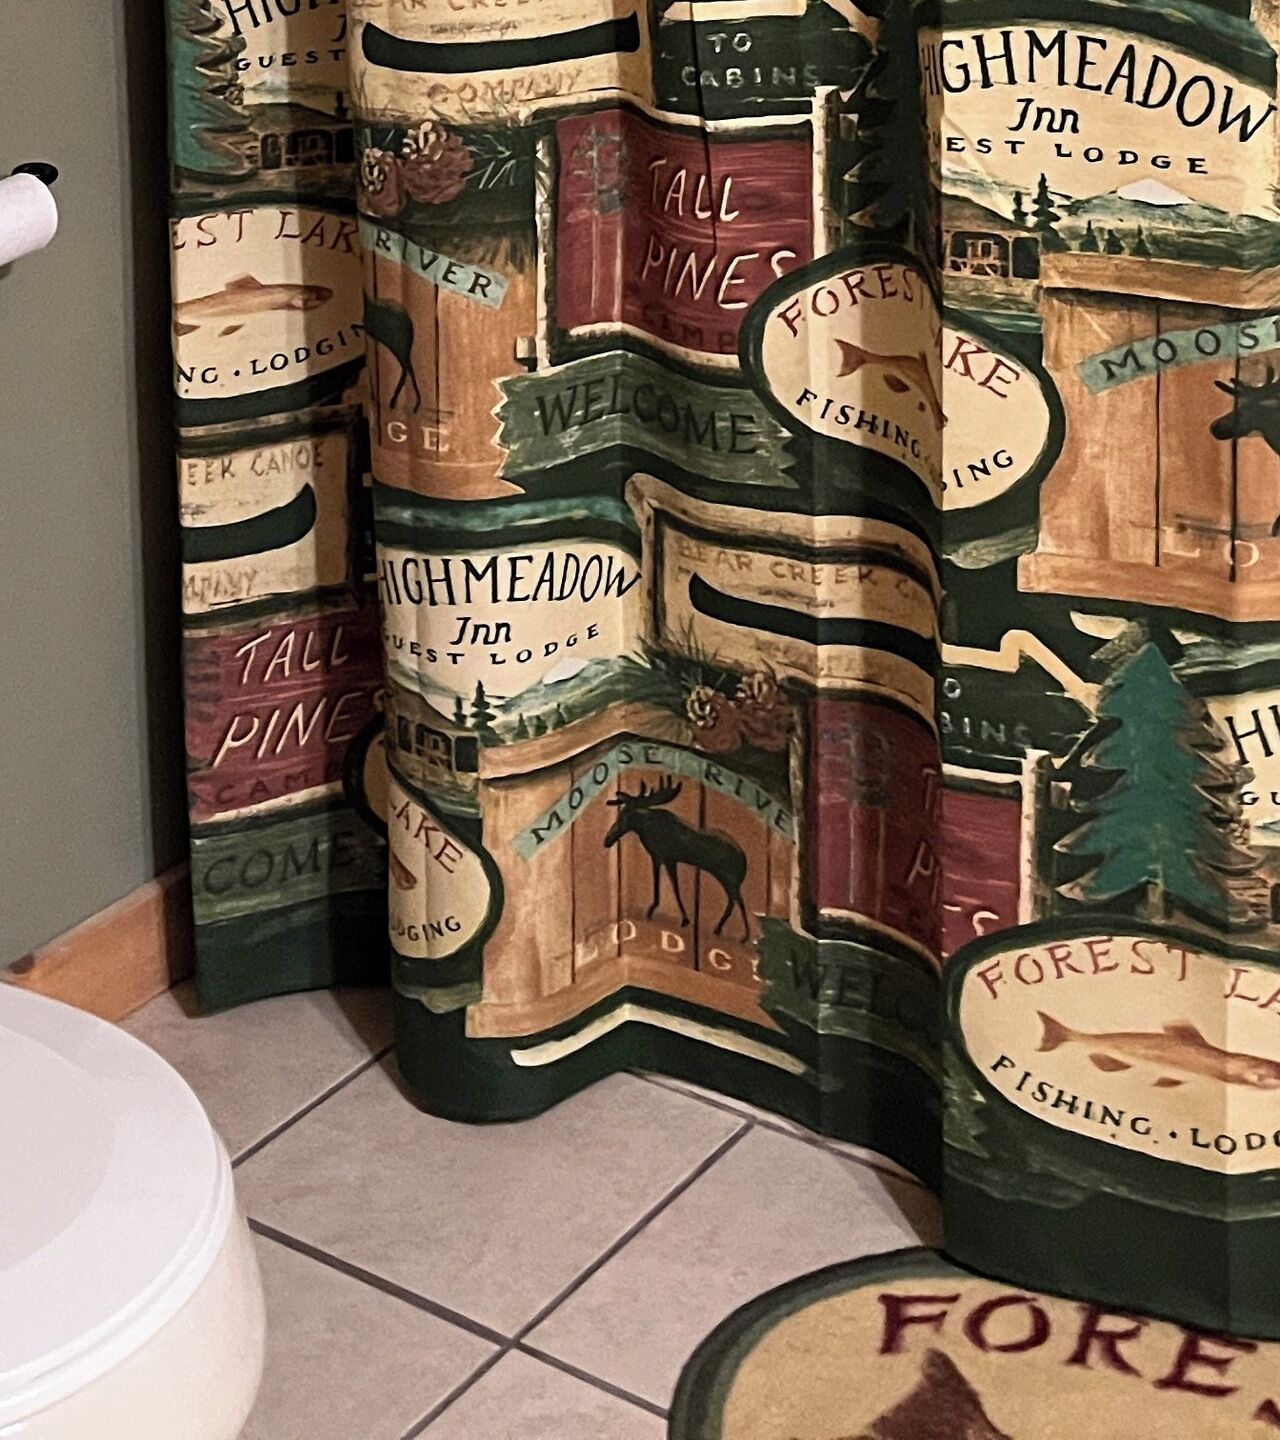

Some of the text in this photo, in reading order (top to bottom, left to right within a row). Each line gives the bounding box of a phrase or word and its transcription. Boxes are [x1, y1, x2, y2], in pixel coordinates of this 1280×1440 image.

[706, 31, 753, 55] TO
[1007, 97, 1081, 136] Inn
[1054, 143, 1210, 175] LODGE
[648, 158, 740, 224] TALL
[374, 225, 494, 300] RIVER
[769, 560, 878, 588] CREEK
[234, 624, 351, 686] TALL
[449, 615, 512, 647] Inn
[489, 622, 601, 665] LODGE
[529, 743, 665, 845] MOOSE
[976, 935, 1204, 1000] FOREST
[989, 1054, 1154, 1137] FISHING
